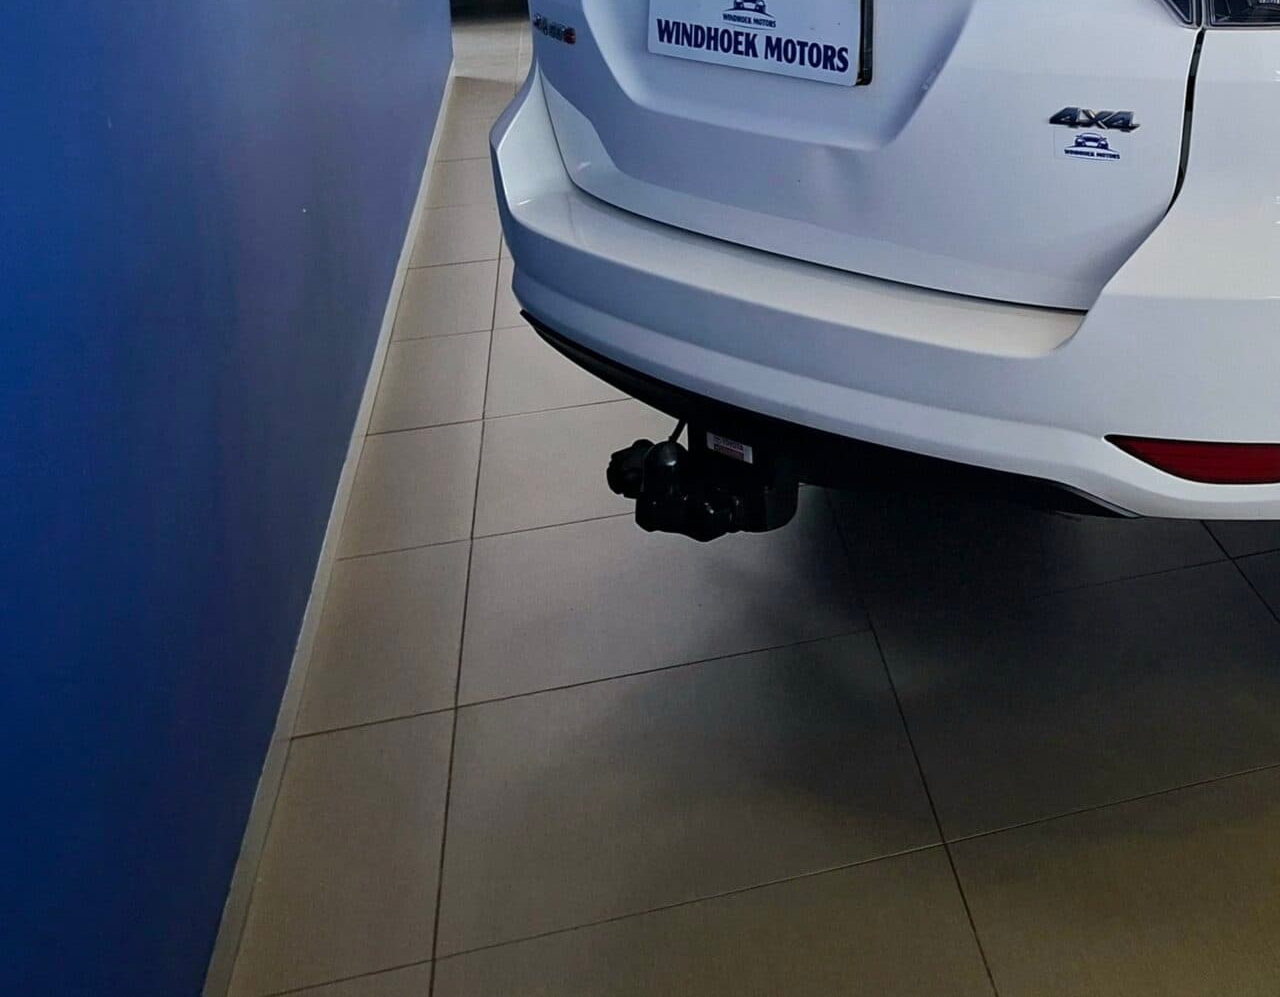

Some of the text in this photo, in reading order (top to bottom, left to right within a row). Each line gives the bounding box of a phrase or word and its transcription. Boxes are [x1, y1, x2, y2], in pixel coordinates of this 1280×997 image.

[753, 17, 777, 28] MOTORS
[656, 17, 849, 74] WINDHOEK MOTORS
